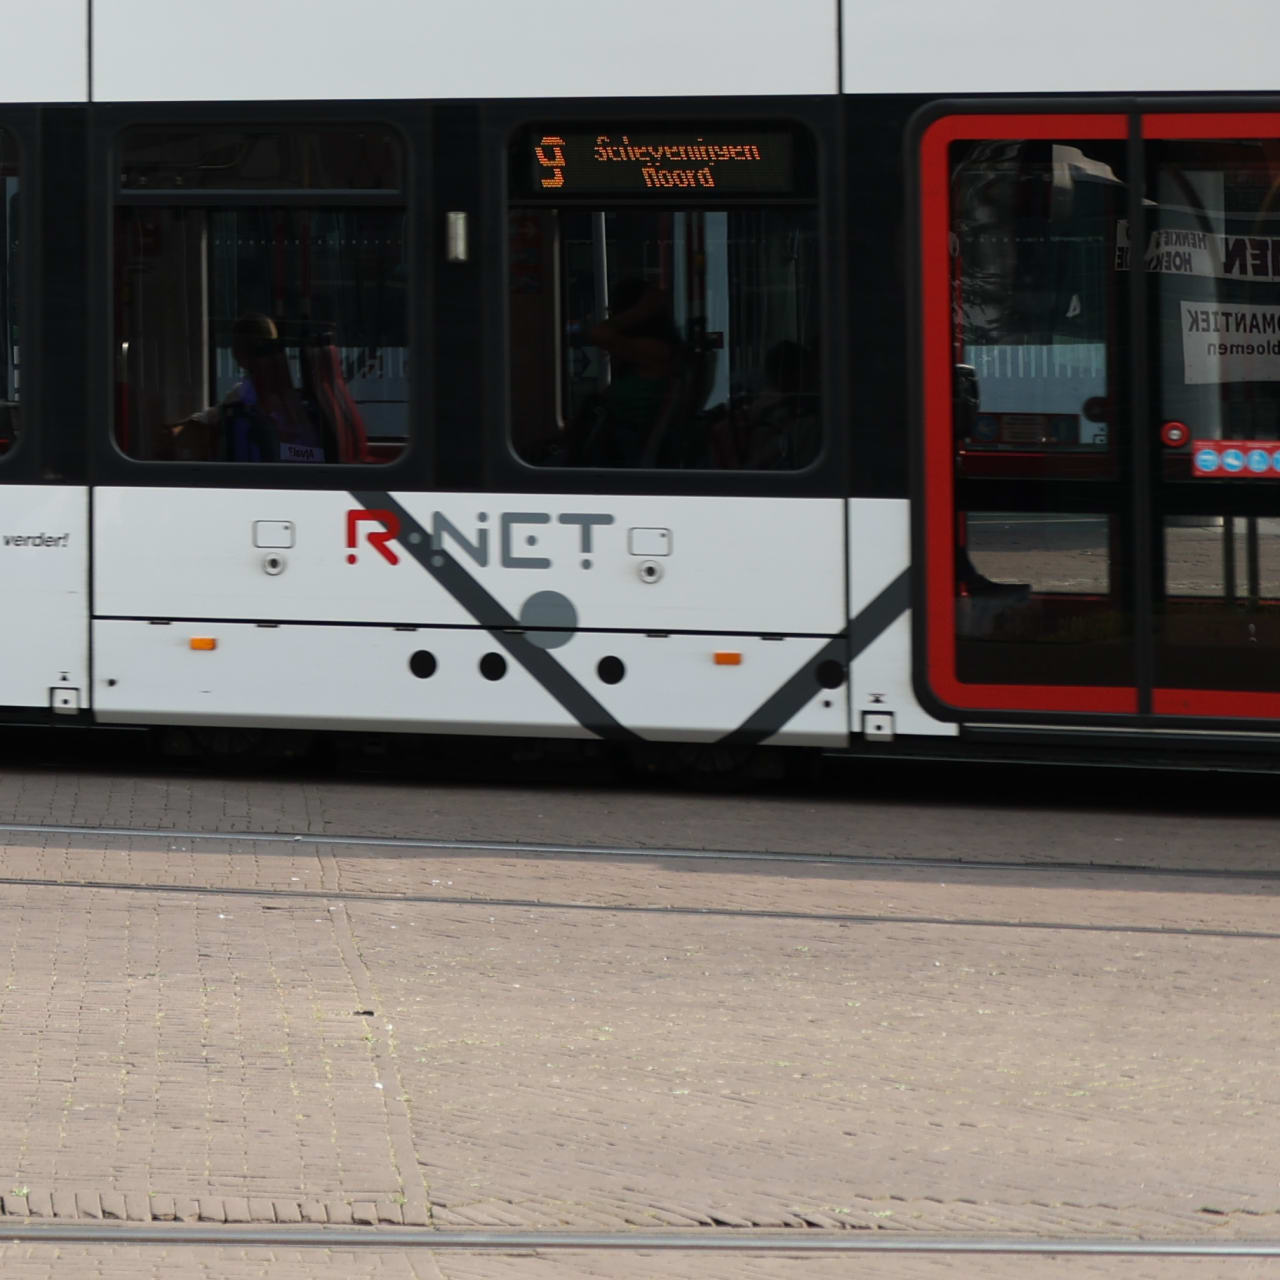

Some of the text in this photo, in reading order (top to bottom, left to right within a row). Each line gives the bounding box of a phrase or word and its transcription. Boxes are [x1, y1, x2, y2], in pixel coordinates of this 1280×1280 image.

[594, 136, 761, 161] Scheveningen
[642, 162, 716, 187] Noord
[2, 532, 70, 548] verder!
